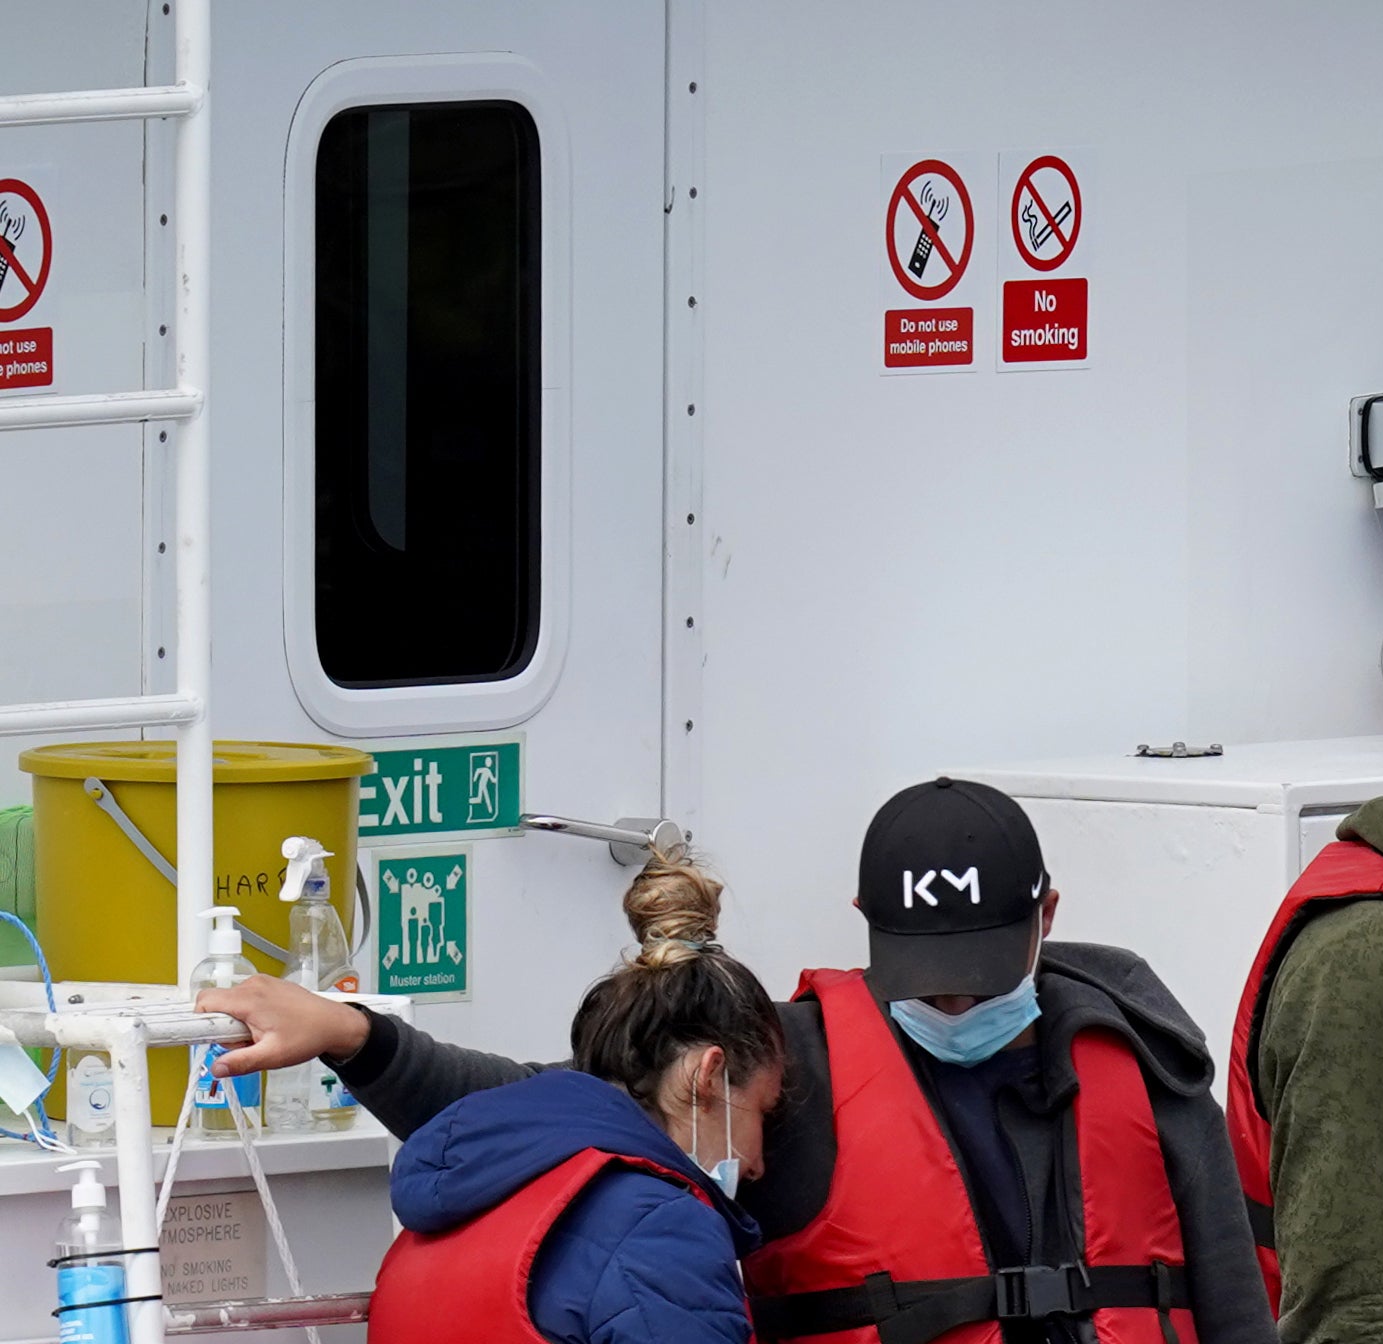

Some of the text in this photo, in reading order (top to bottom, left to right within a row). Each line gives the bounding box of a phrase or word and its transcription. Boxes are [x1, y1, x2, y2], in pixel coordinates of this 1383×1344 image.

[1033, 289, 1057, 312] No
[900, 317, 958, 333] Do not use
[1010, 324, 1079, 350] smoking
[16, 340, 37, 353] use
[889, 338, 968, 356] mobile phones
[6, 361, 48, 379] phones
[358, 758, 443, 827] Exit
[903, 866, 981, 909] KM
[389, 972, 455, 987] Muster station
[183, 1258, 232, 1276] SMOKING
[168, 1276, 248, 1296] NAKED LIGHTS
